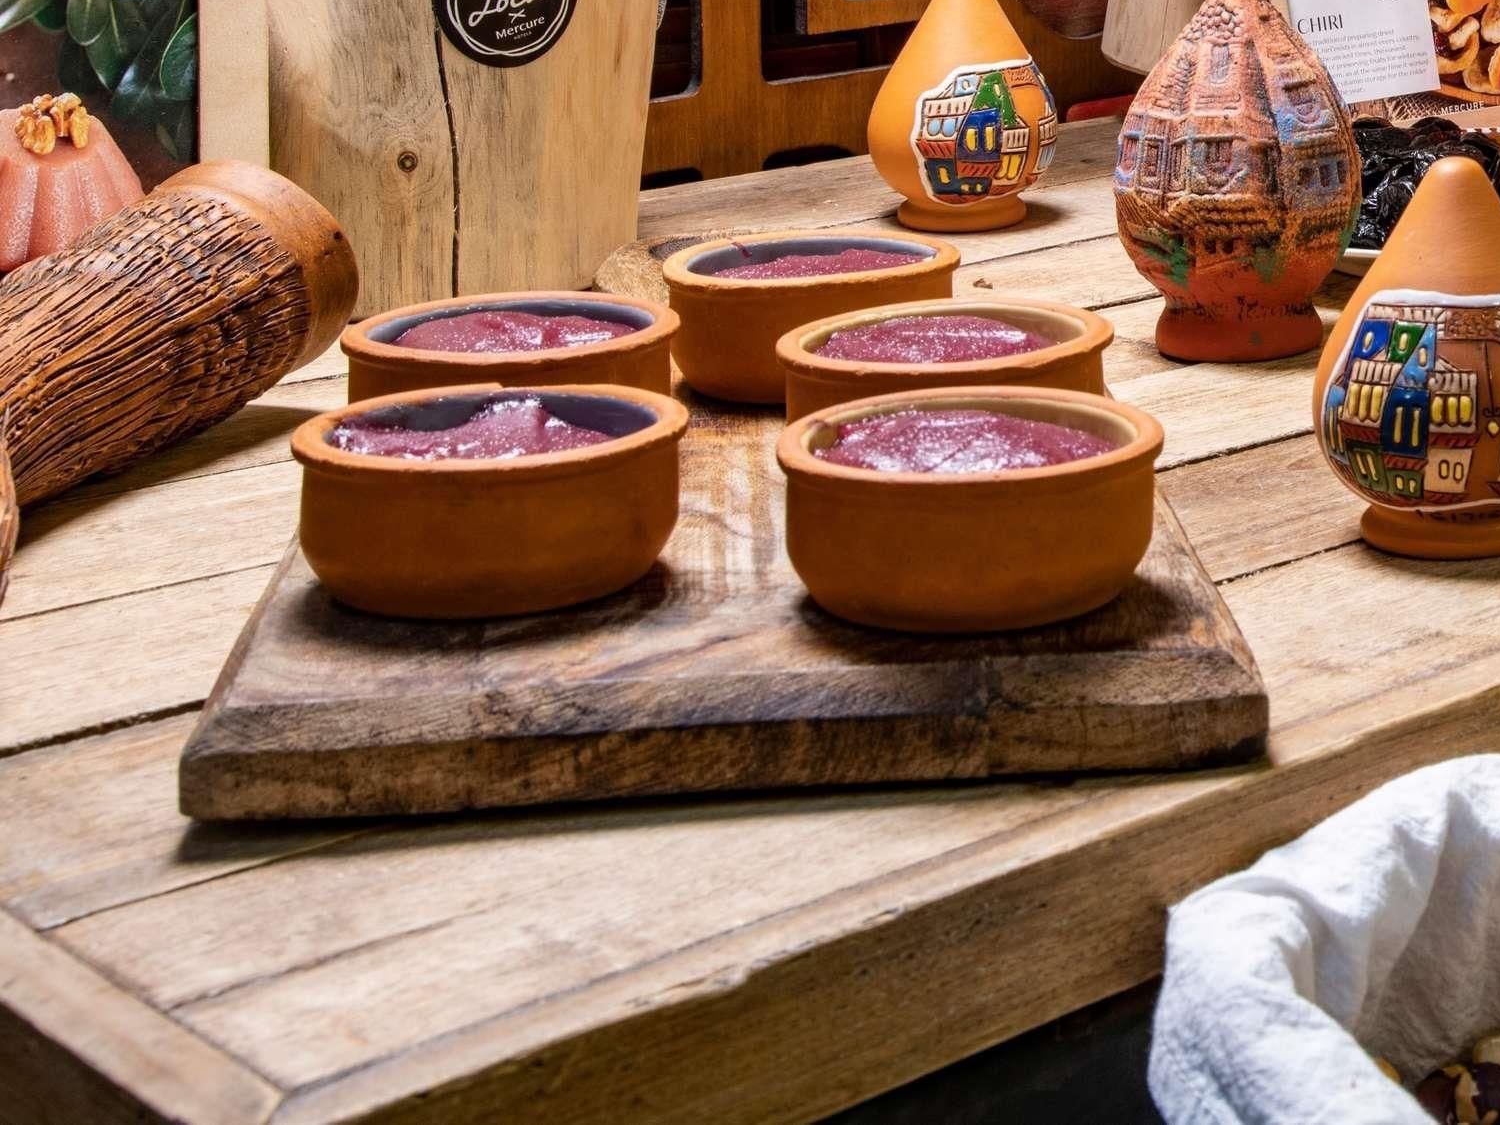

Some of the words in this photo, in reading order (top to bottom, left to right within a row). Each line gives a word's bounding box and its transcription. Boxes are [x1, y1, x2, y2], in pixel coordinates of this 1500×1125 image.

[495, 16, 545, 40] Mercure
[1297, 13, 1344, 34] CHIRI
[1440, 101, 1485, 116] MERCURE
